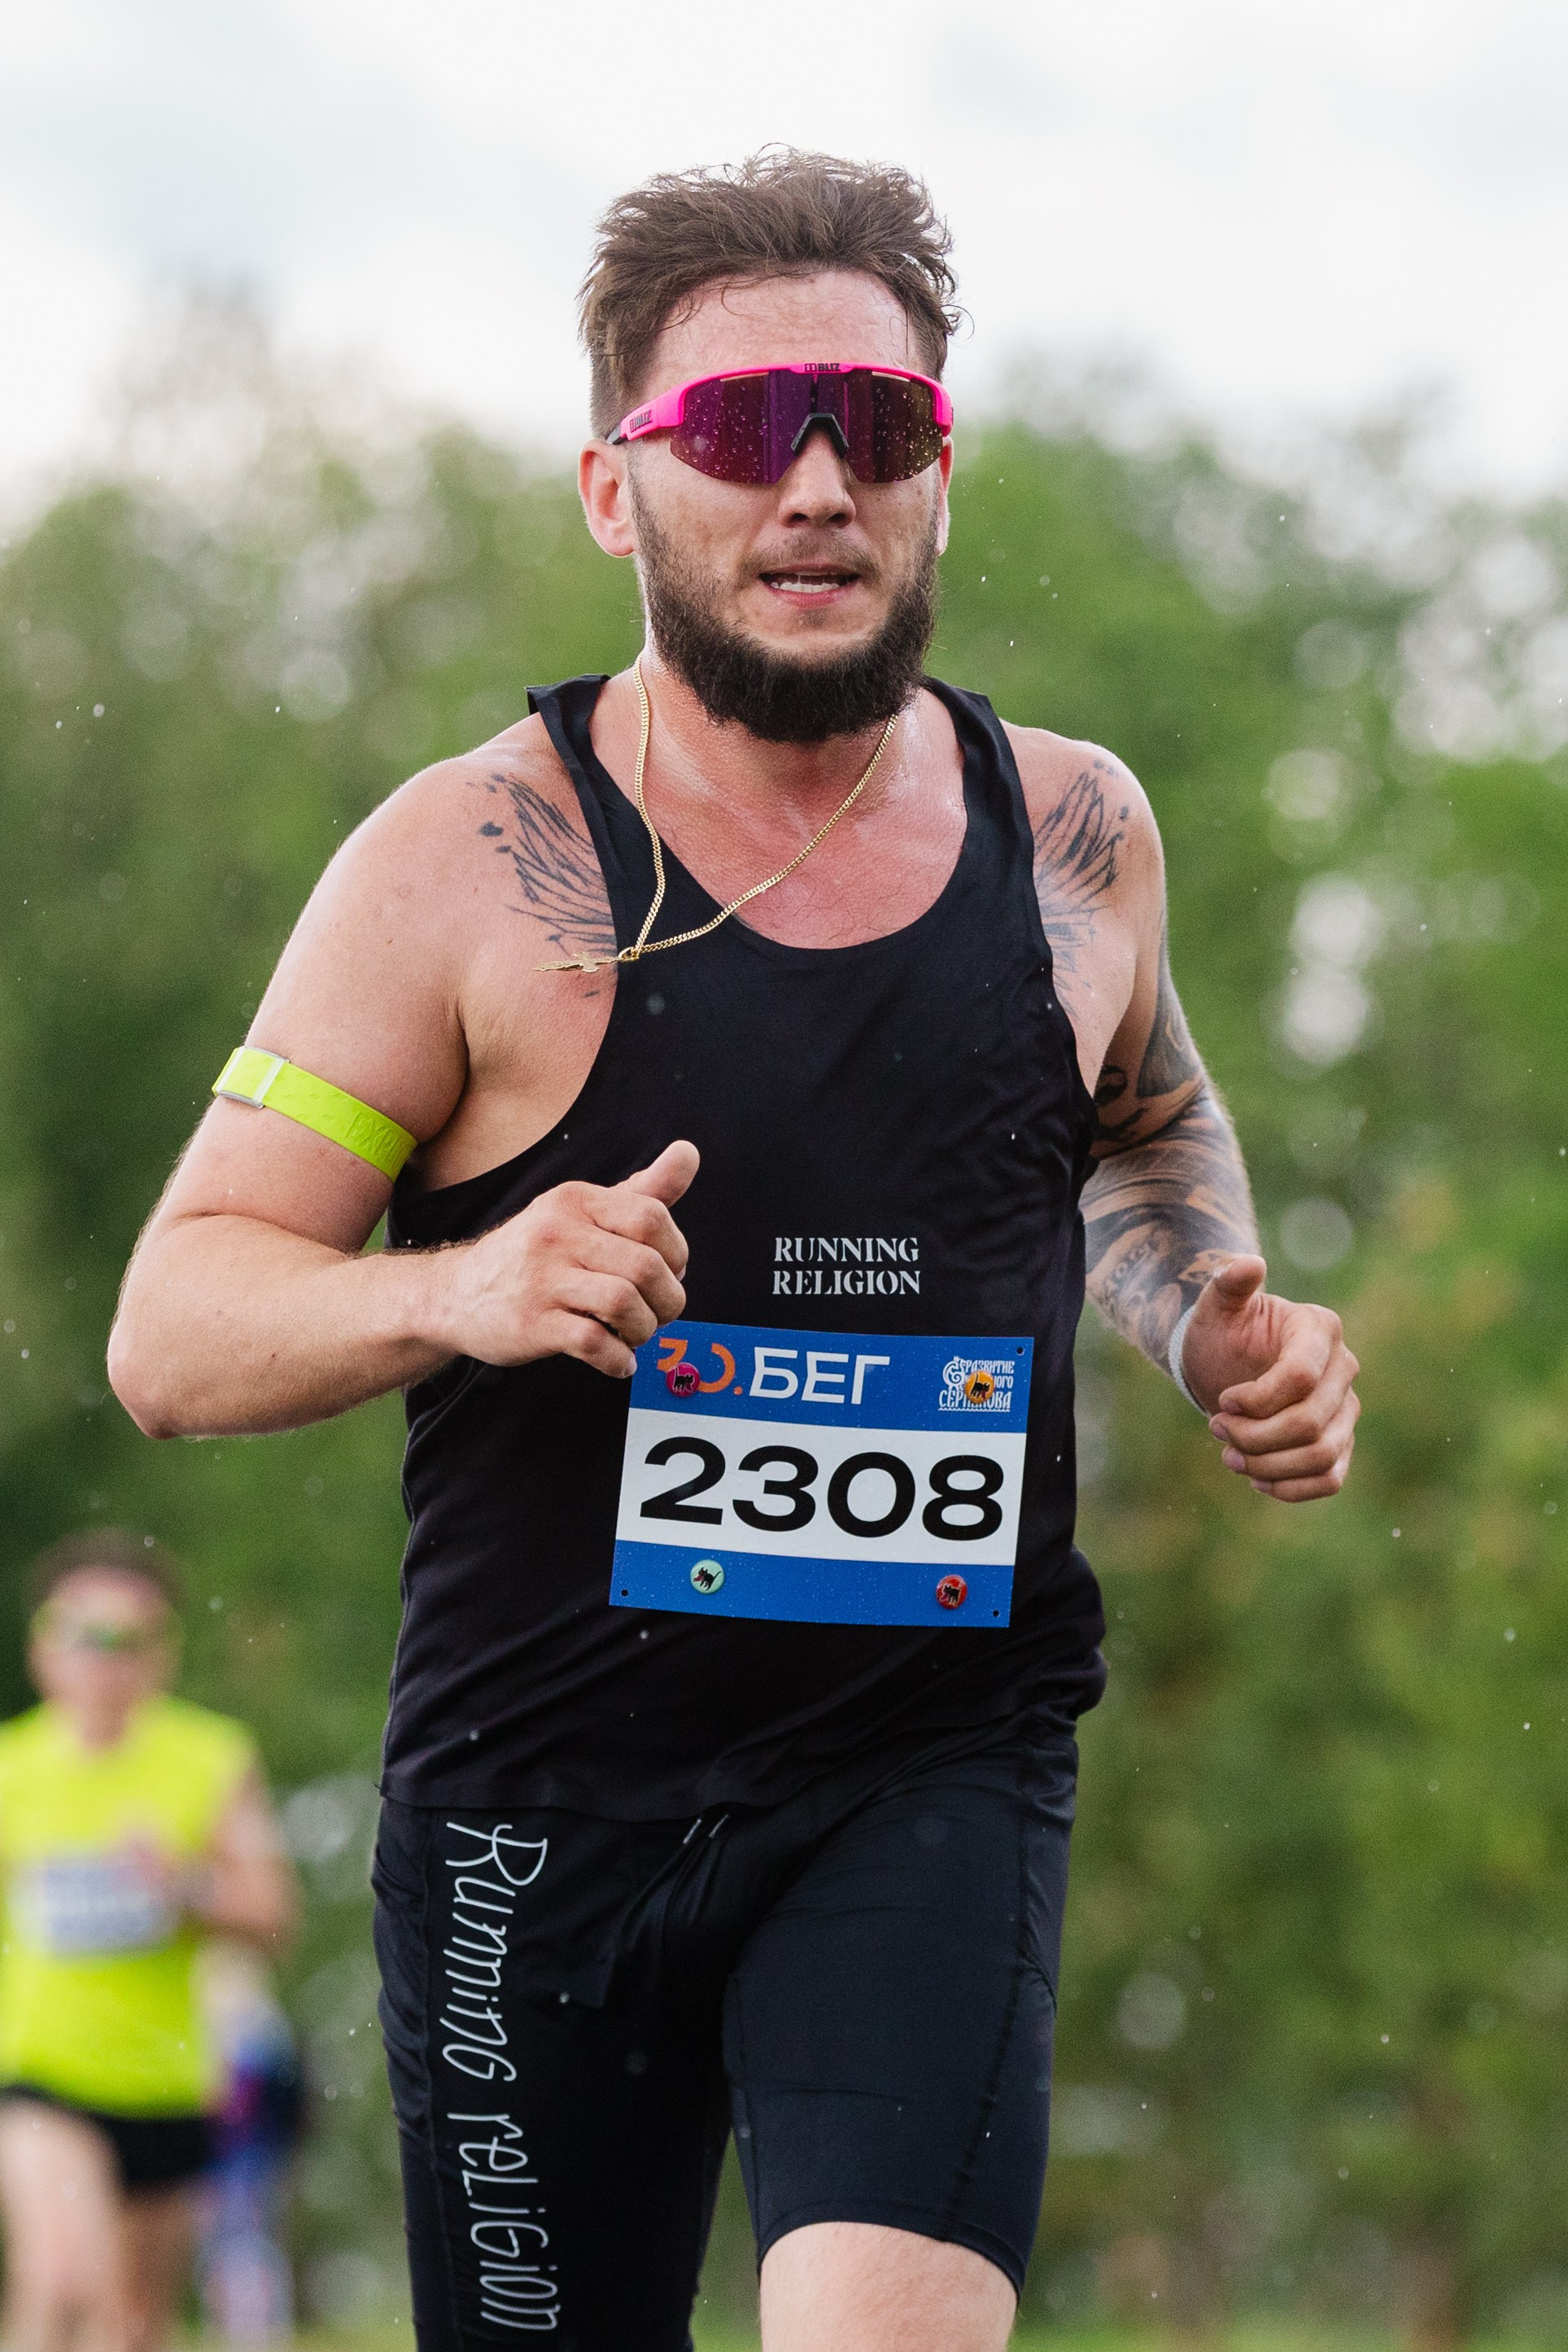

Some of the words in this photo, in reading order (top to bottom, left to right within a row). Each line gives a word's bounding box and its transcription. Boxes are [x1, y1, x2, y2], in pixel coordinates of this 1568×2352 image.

[774, 1237, 919, 1261] RUNNING
[772, 1270, 920, 1295] RELIGION
[640, 1436, 1005, 1541] 2308
